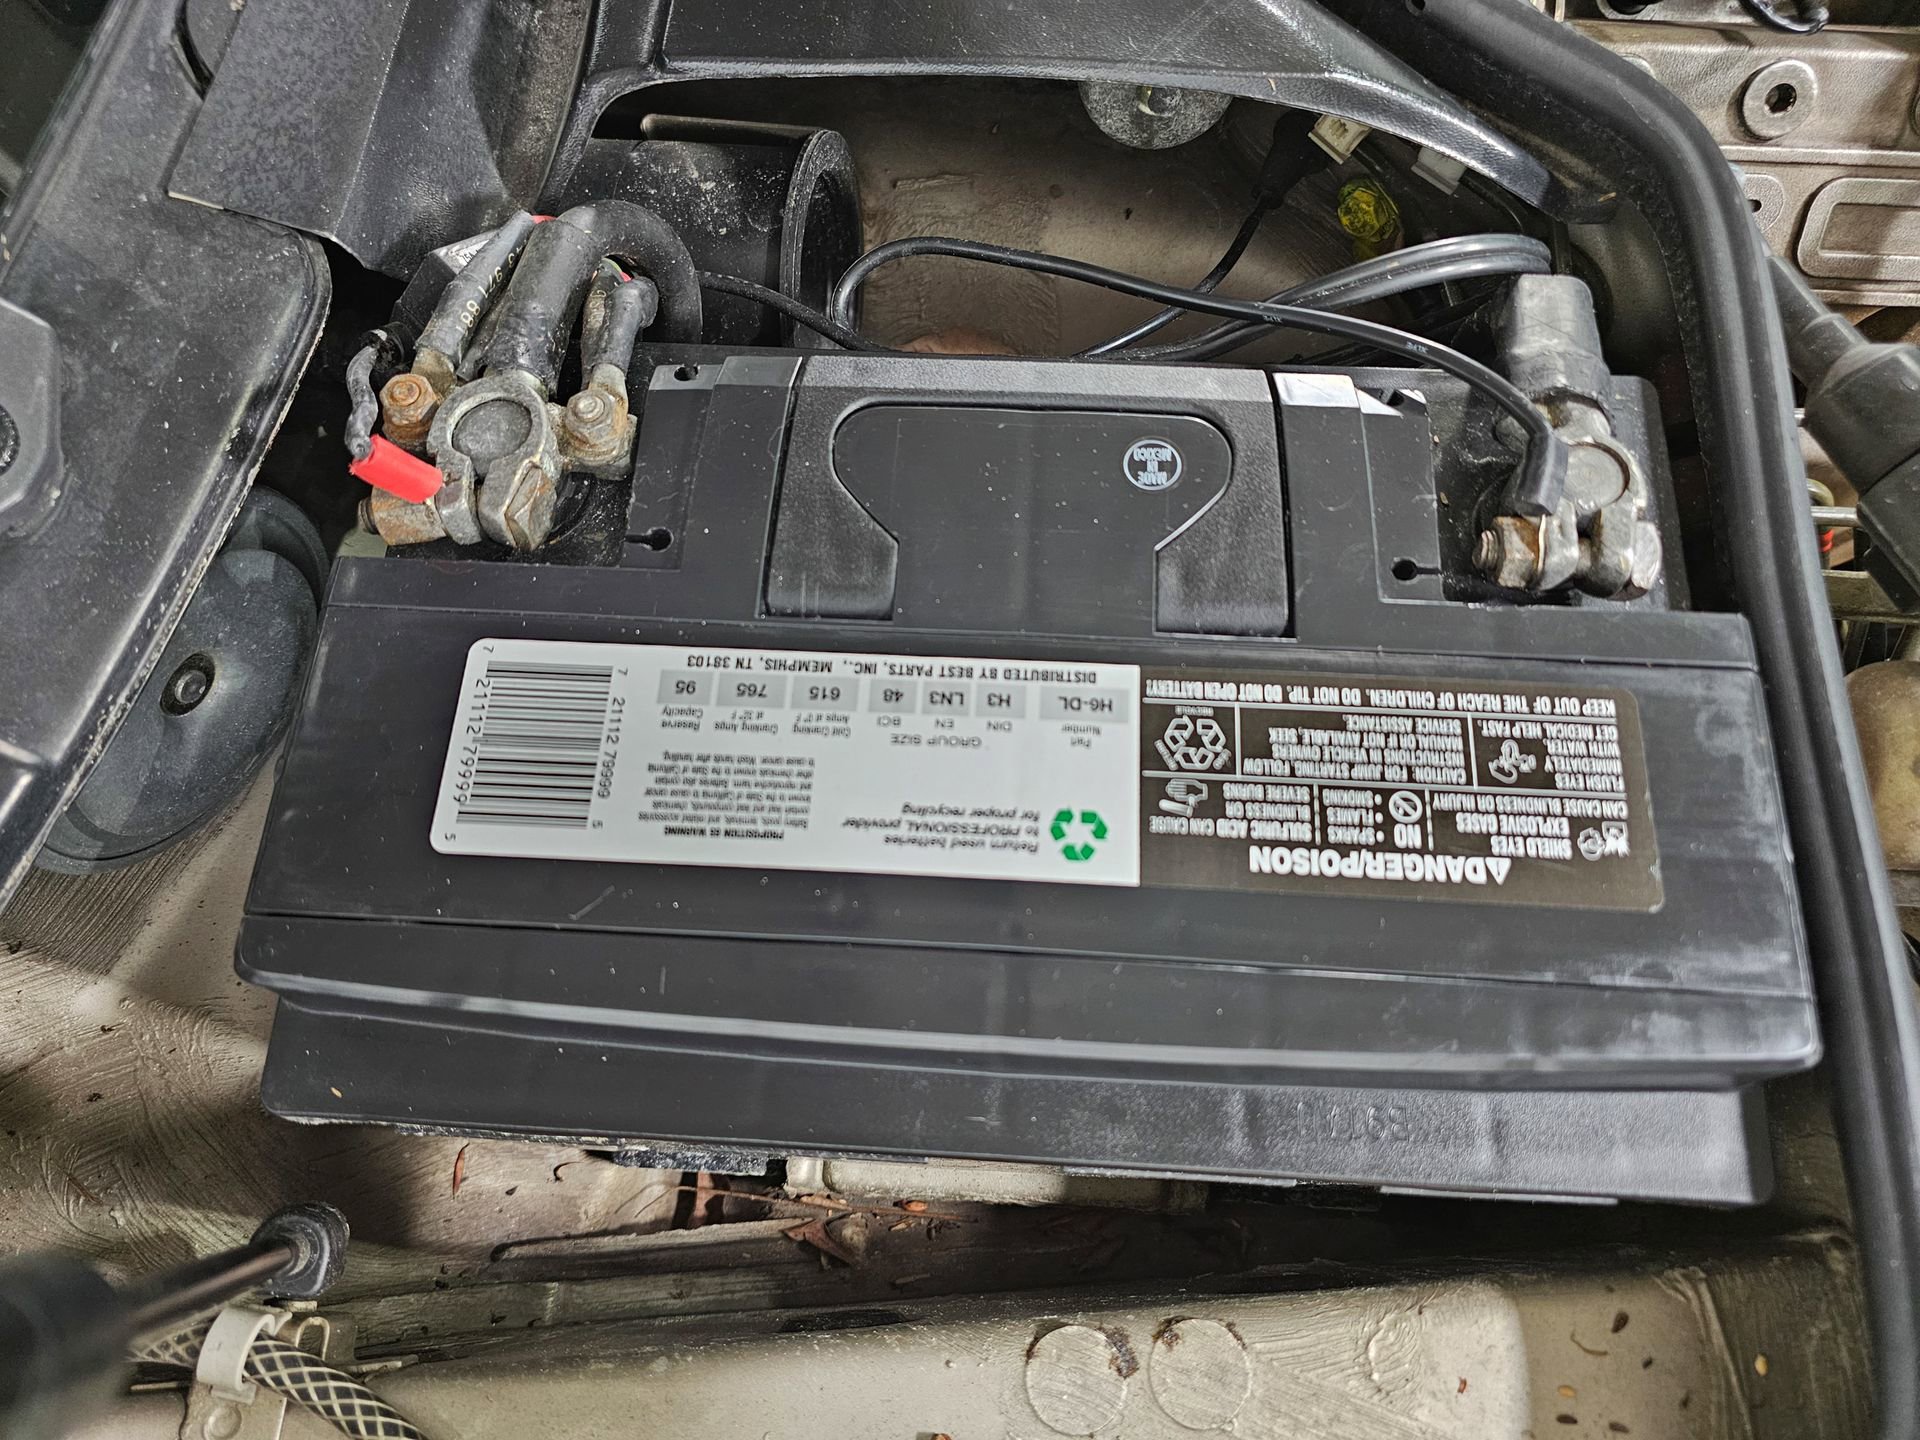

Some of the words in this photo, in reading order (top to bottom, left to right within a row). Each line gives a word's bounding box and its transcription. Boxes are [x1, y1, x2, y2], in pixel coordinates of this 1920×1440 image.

[1133, 448, 1172, 461] MEXICO
[1147, 460, 1158, 472] IN
[1137, 471, 1167, 485] MADE
[483, 645, 494, 653] 7
[687, 655, 730, 668] 38103
[735, 657, 752, 670] TN
[759, 656, 833, 673] MEMPHIS,
[843, 660, 877, 674] INC.,
[883, 662, 933, 677] PARTS,
[617, 667, 628, 676] 7
[938, 665, 974, 679] BEST
[979, 667, 998, 680] BY
[1003, 668, 1097, 684] DISTRIBUTED
[675, 680, 697, 694] 95
[736, 683, 768, 698] 765
[808, 686, 841, 701] 615
[882, 689, 904, 703] 48
[1145, 679, 1204, 700] BATTERY!
[1204, 682, 1237, 701] OPEN
[1238, 683, 1263, 702] NOT
[1264, 684, 1283, 703] DO
[1286, 685, 1311, 704] TIP.
[1311, 686, 1340, 705] NOT
[929, 690, 964, 706] LN3
[987, 693, 1012, 708] H3
[1058, 696, 1113, 713] H6-DL
[1341, 687, 1361, 706] DO
[1365, 689, 1435, 709] CHILDREN.
[1437, 691, 1455, 710] OF
[1457, 692, 1502, 712] REACH
[1502, 694, 1529, 713] THE
[1532, 695, 1552, 714] OF
[466, 679, 490, 735] 21112
[662, 706, 704, 718] Capacity
[1553, 697, 1581, 715] OUT
[1582, 698, 1616, 717] KEEP
[606, 697, 625, 745] 21112
[661, 720, 701, 732] Reserve
[876, 715, 901, 727] BCI
[934, 718, 954, 729] EN
[986, 720, 1012, 732] DIN
[1061, 724, 1101, 735] Number
[1342, 714, 1413, 734] ASSISTANCE.
[1415, 717, 1462, 735] SERVICE
[1477, 719, 1511, 738] FAST.
[1512, 721, 1543, 739] HELP
[889, 733, 922, 746] SIZE
[1268, 727, 1298, 744] SEEK
[1362, 731, 1386, 748] NOT
[1543, 722, 1594, 740] MEDICAL
[1594, 725, 1618, 741] GET
[926, 734, 982, 748] GROUP
[1386, 733, 1398, 749] IF
[1399, 734, 1416, 750] OR
[1416, 734, 1464, 751] MANUAL
[1542, 738, 1588, 756] WATER.
[1588, 740, 1620, 758] WITH
[1271, 743, 1320, 761] OWNERS
[1322, 746, 1368, 764] VEHICLE
[1368, 748, 1383, 765] IN
[1384, 748, 1465, 767] INSTRUCTIONS
[1243, 758, 1291, 776] FOLLOW
[1350, 763, 1383, 781] JUMP
[1384, 765, 1408, 782] FOR
[1544, 755, 1623, 774] IMMEDIATELY
[453, 745, 477, 806] 79999
[597, 750, 617, 800] 79999
[1412, 766, 1467, 785] CAUTION:
[1555, 772, 1585, 791] EYES
[1586, 773, 1625, 792] FLUSH
[1223, 782, 1264, 801] BURNS
[1265, 785, 1311, 804] SEVERE
[1322, 788, 1374, 807] SMOKING
[901, 802, 966, 818] recycling
[1225, 801, 1245, 818] OR
[1432, 792, 1475, 811] INJURY
[1476, 795, 1495, 813] OR
[1496, 795, 1562, 816] BLINDNESS
[1562, 798, 1602, 818] CAUSE
[1601, 800, 1629, 819] CAN
[970, 807, 1016, 820] proper
[1020, 811, 1040, 822] for
[1245, 802, 1311, 822] BLINDNESS
[1326, 807, 1374, 826] FLAMES
[841, 816, 901, 831] provider
[905, 820, 1020, 836] PROFESSIONAL
[1025, 826, 1039, 836] to
[1149, 815, 1189, 835] CAUSE
[1189, 817, 1215, 836] CAN
[1216, 818, 1248, 839] ACID
[1250, 819, 1312, 842] SULFURIC
[1456, 812, 1498, 835] GASES
[1498, 814, 1569, 837] EXPLOSIVE
[444, 833, 456, 842] 5
[883, 836, 947, 848] batteries
[950, 838, 986, 850] used
[1327, 825, 1375, 845] SPARKS
[1393, 823, 1422, 849] NO
[990, 840, 1039, 854] Return
[1490, 835, 1525, 857] EYES
[1526, 837, 1572, 860] SHIELD
[1249, 845, 1487, 884] DANGER/POISON
